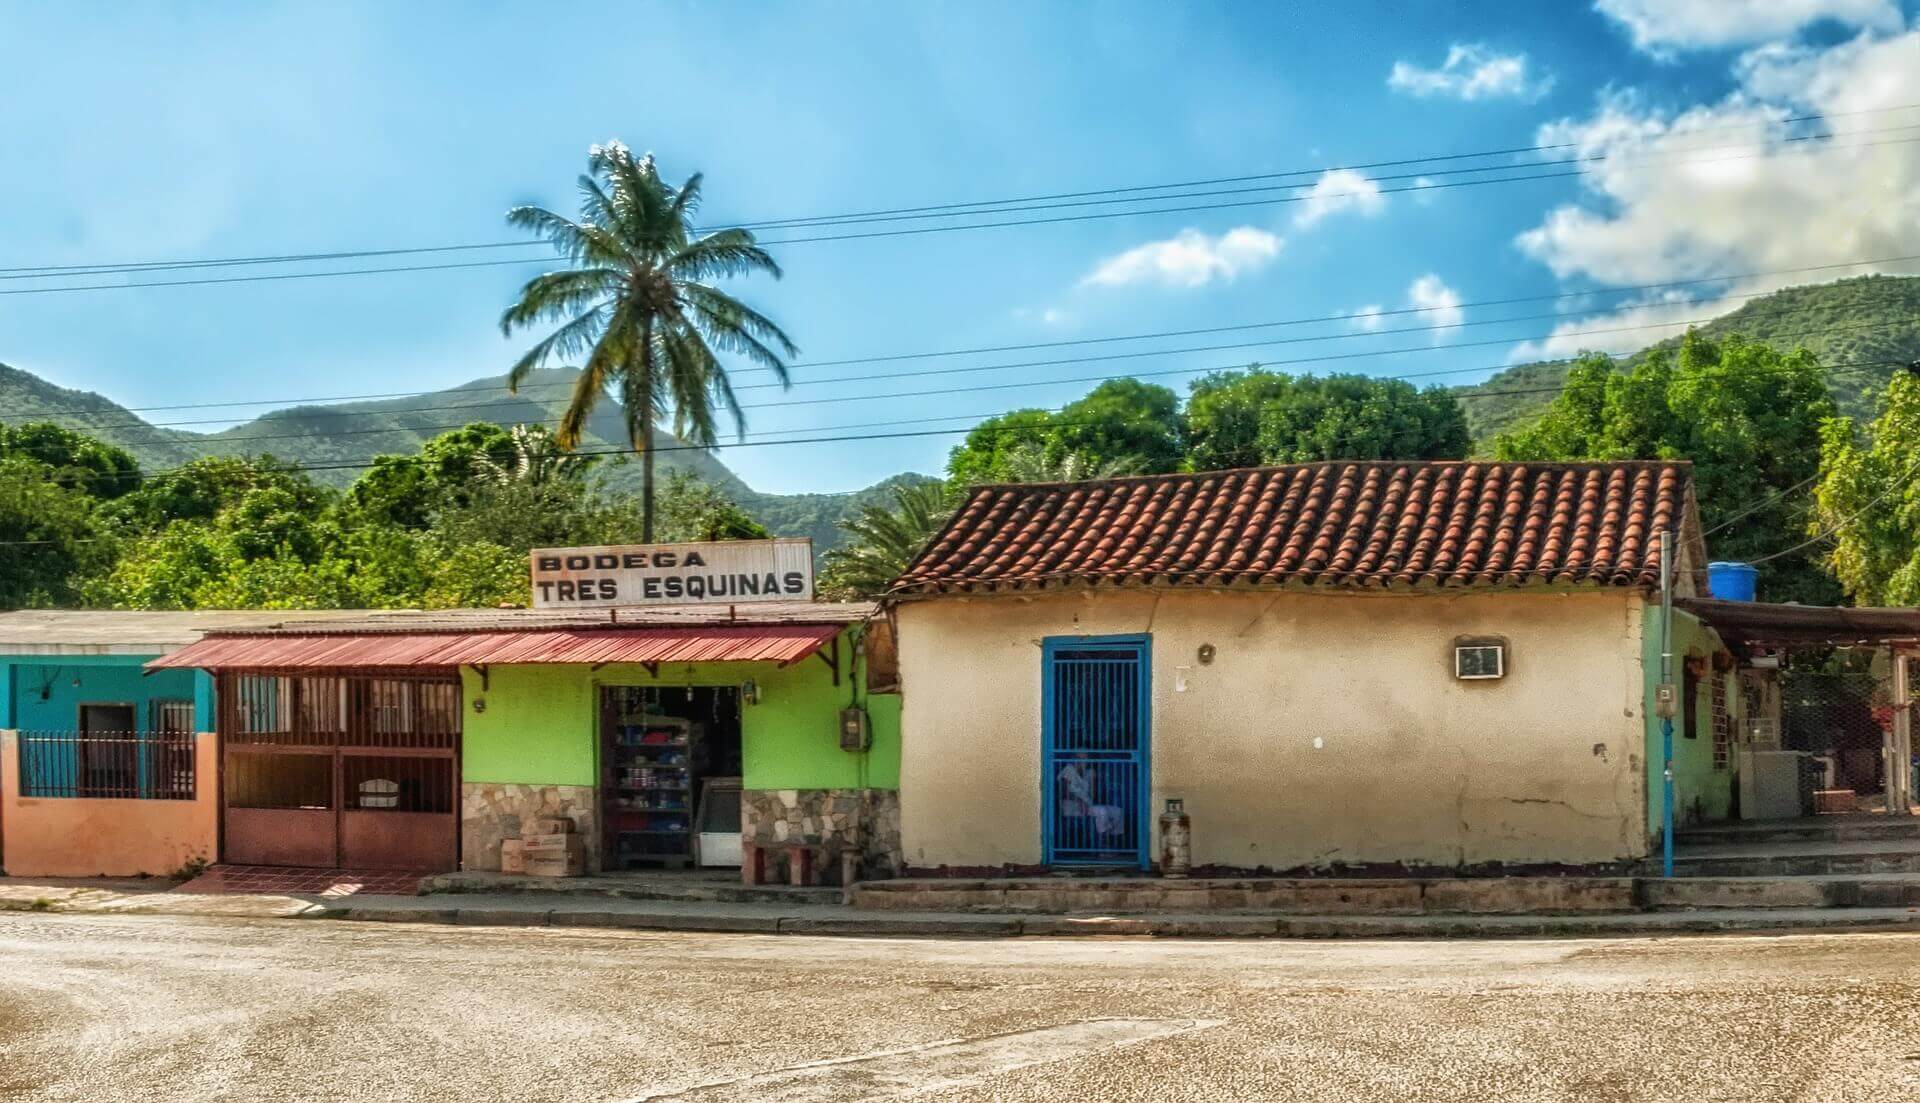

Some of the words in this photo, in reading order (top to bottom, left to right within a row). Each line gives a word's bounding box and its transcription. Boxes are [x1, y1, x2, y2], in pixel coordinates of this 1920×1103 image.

[538, 551, 707, 571] BODEGA
[536, 578, 618, 602] TRES
[643, 572, 804, 600] ESQUINAS
